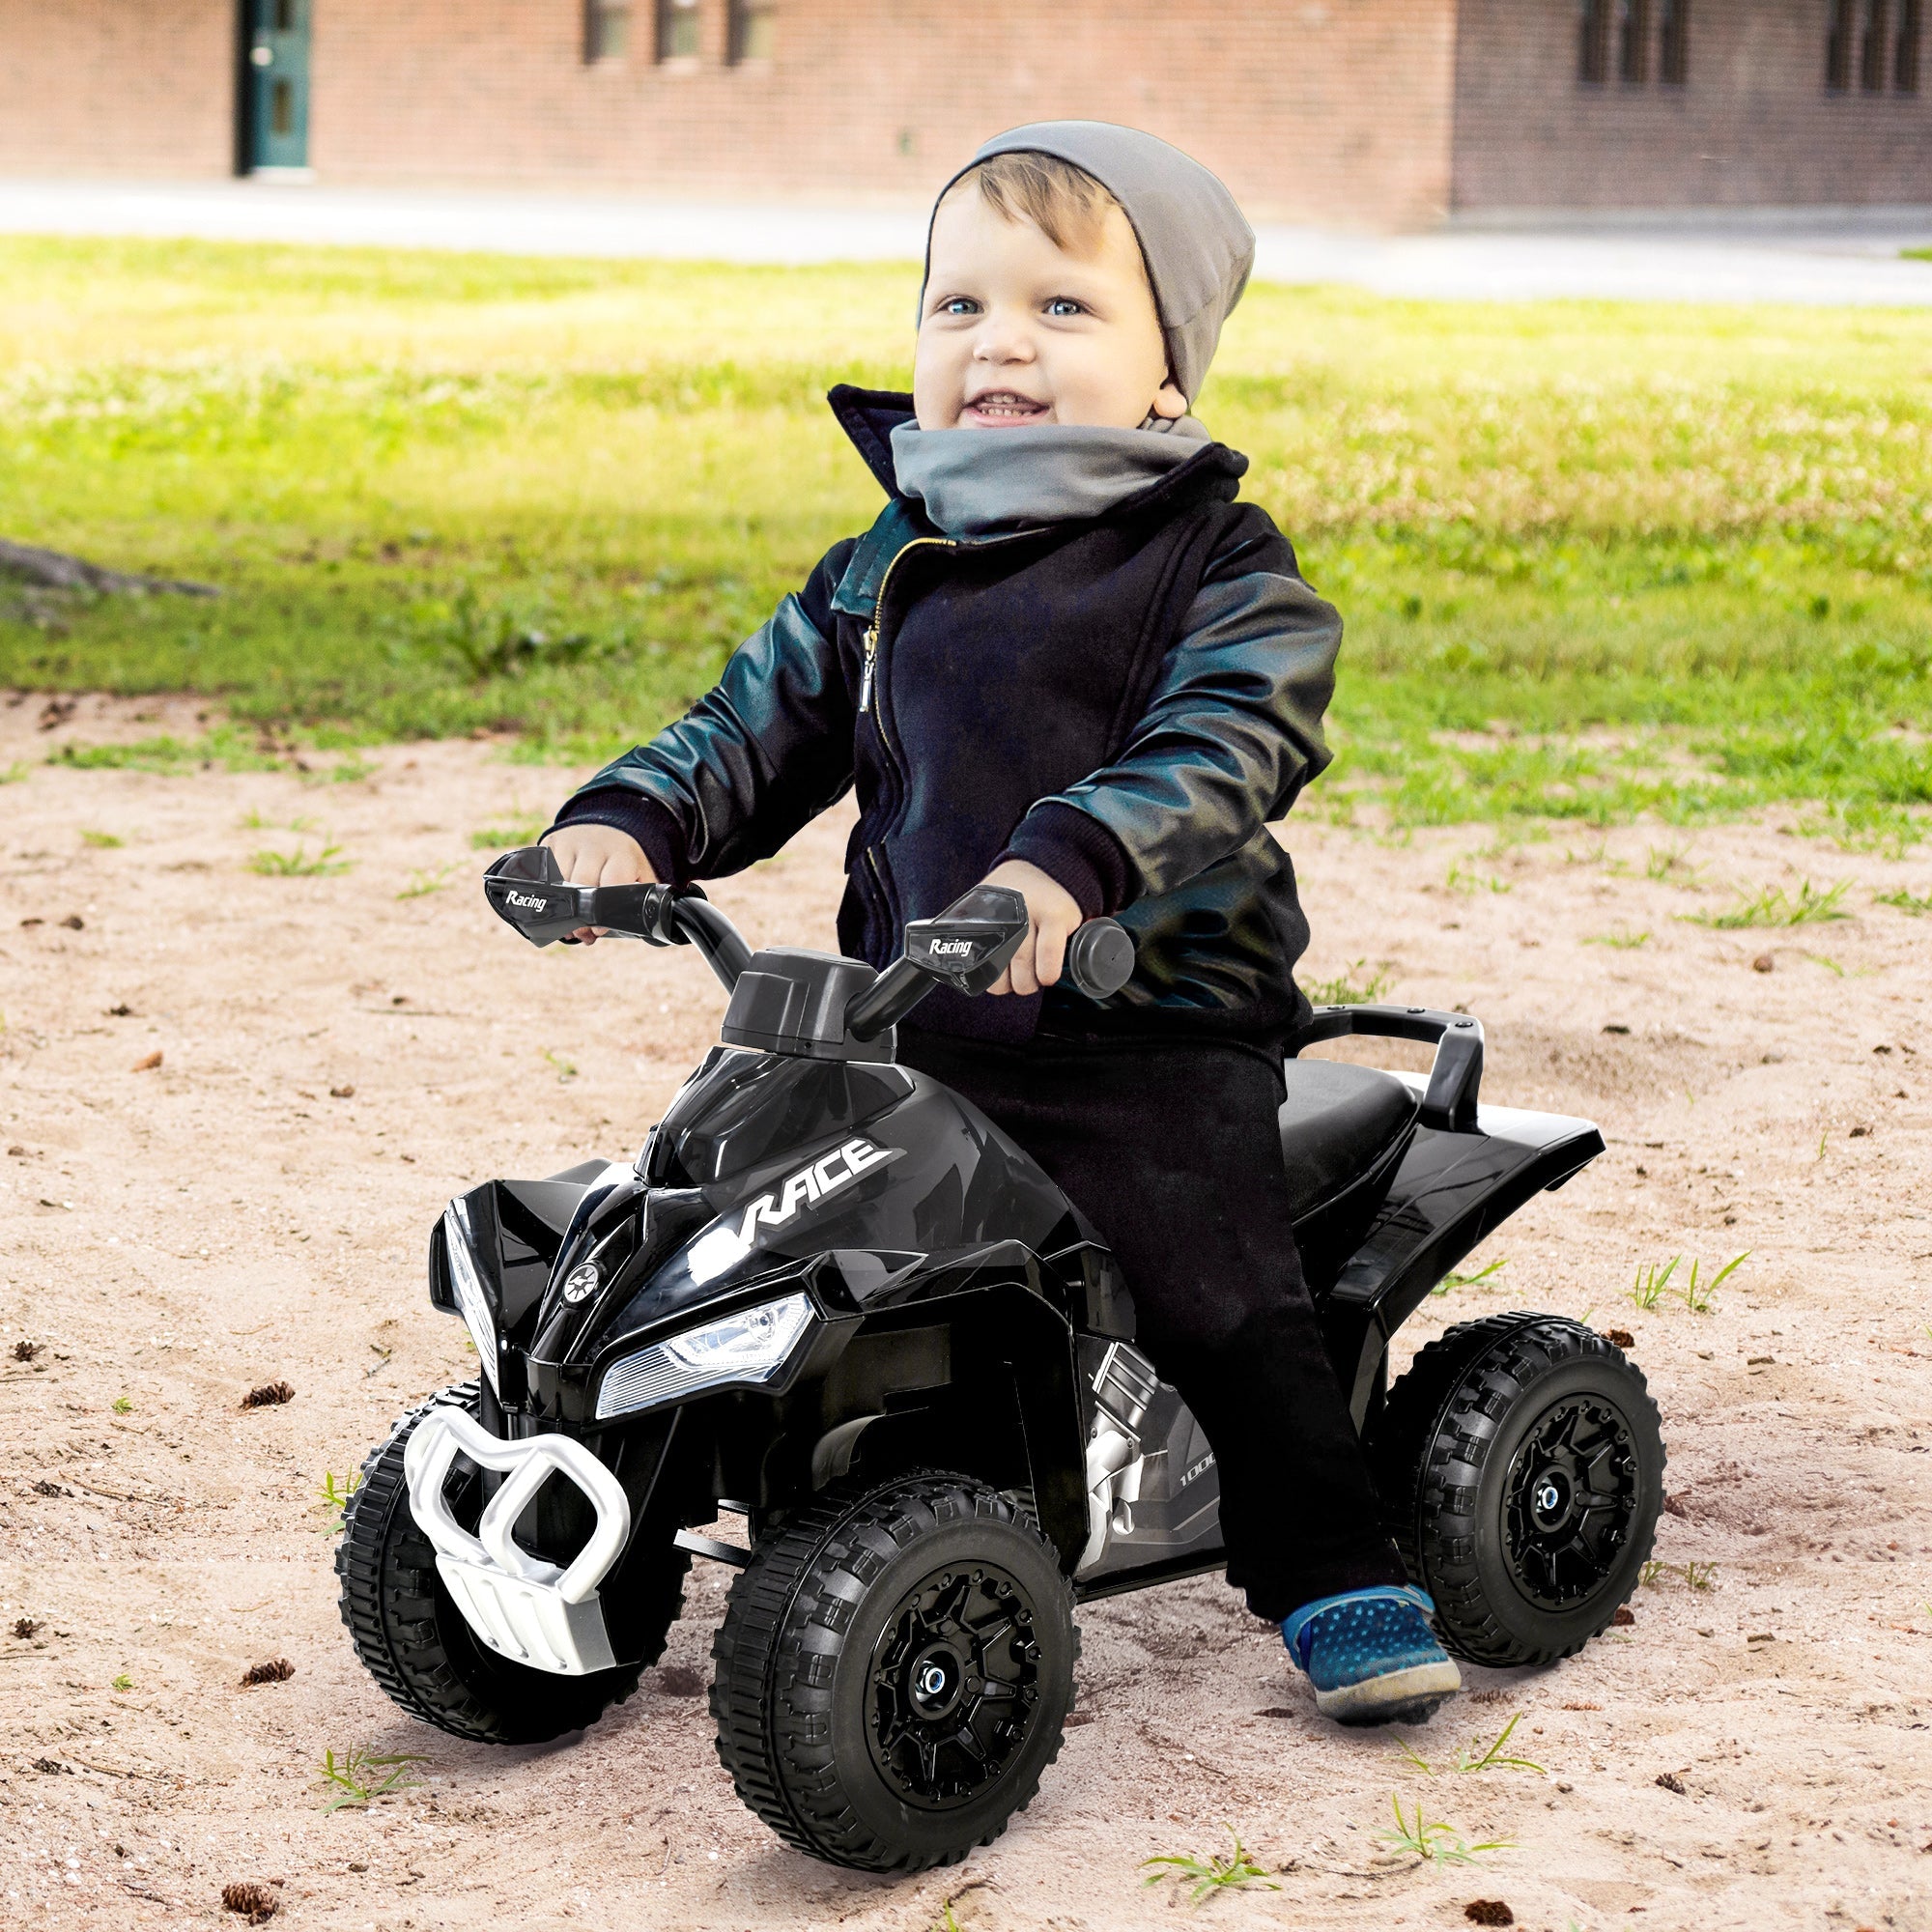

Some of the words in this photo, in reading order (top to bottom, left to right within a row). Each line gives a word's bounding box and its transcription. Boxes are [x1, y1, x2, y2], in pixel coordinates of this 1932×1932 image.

[505, 890, 547, 912] Racing
[928, 938, 973, 957] Racing
[737, 1138, 895, 1247] RACE
